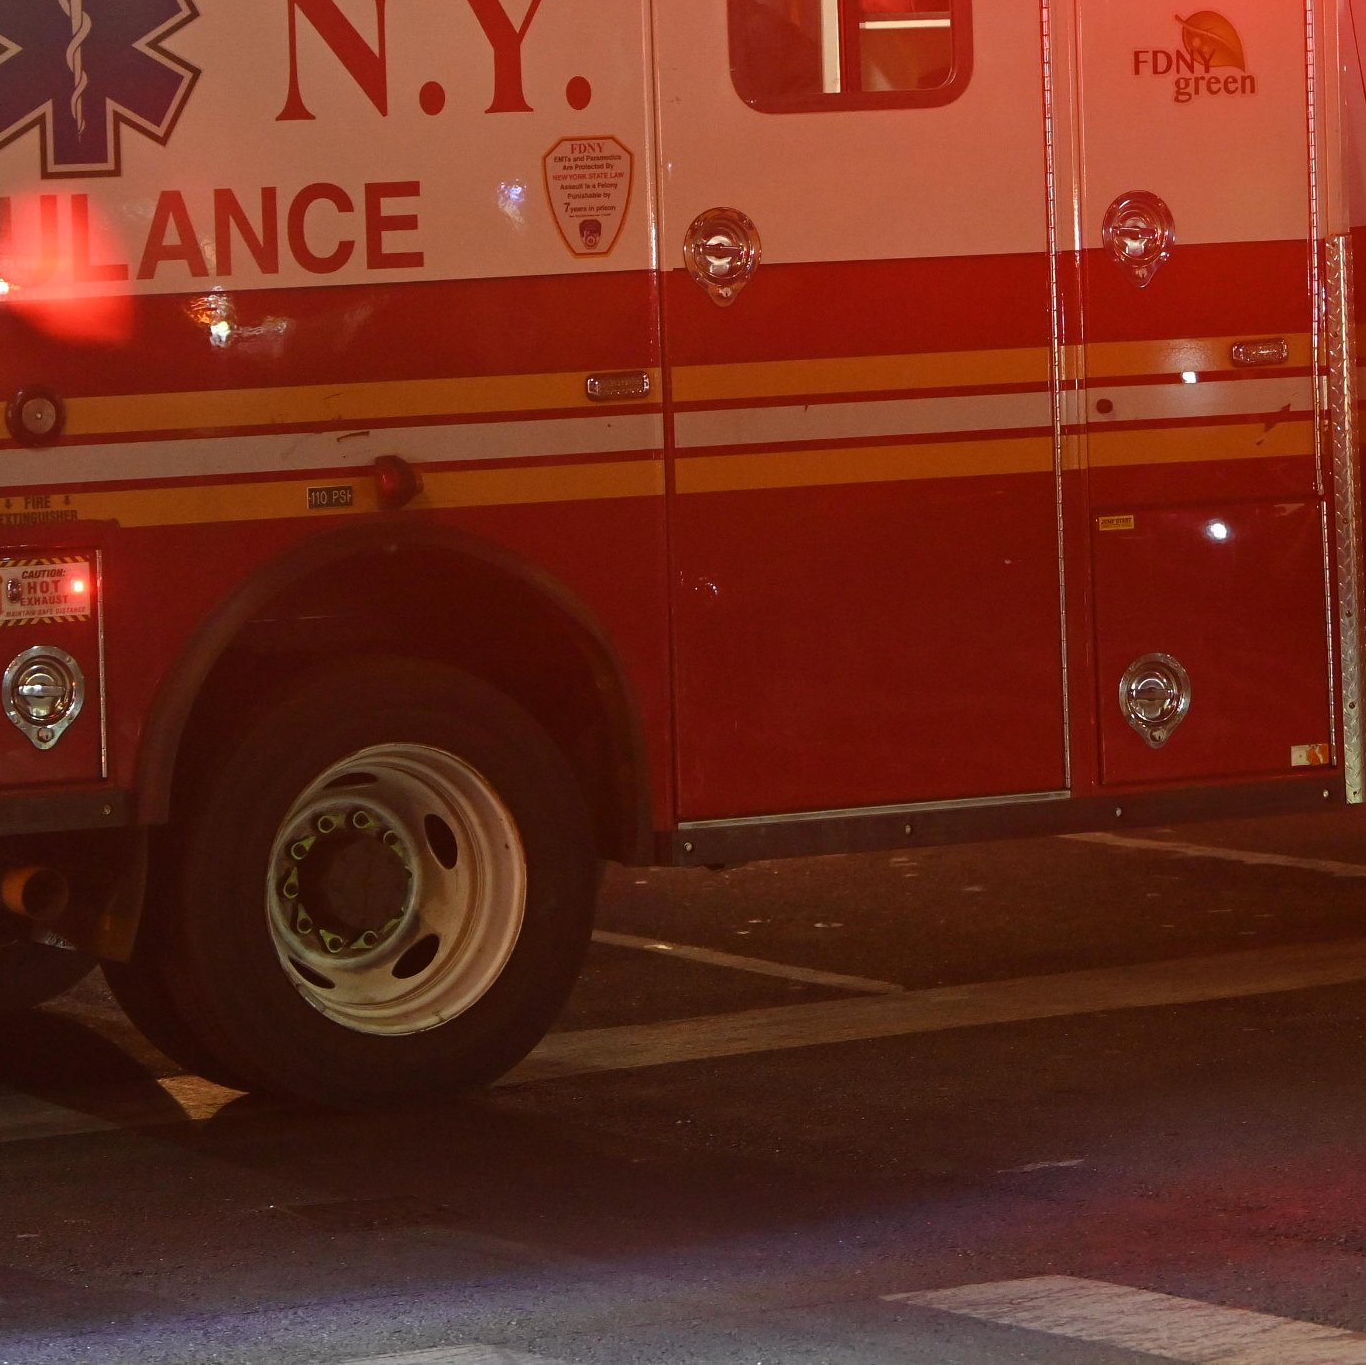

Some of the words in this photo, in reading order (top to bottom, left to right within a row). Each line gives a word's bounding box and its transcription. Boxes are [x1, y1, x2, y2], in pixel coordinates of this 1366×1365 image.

[1133, 49, 1216, 75] FDNY
[1173, 74, 1256, 103] green
[570, 142, 605, 154] FDNY
[563, 202, 570, 213] 7
[24, 496, 51, 509] FIRE
[311, 490, 328, 505] 110
[332, 489, 350, 504] PSI
[21, 568, 66, 580] CAUTION:
[27, 580, 61, 595] HOT
[20, 594, 69, 606] EXHAUST
